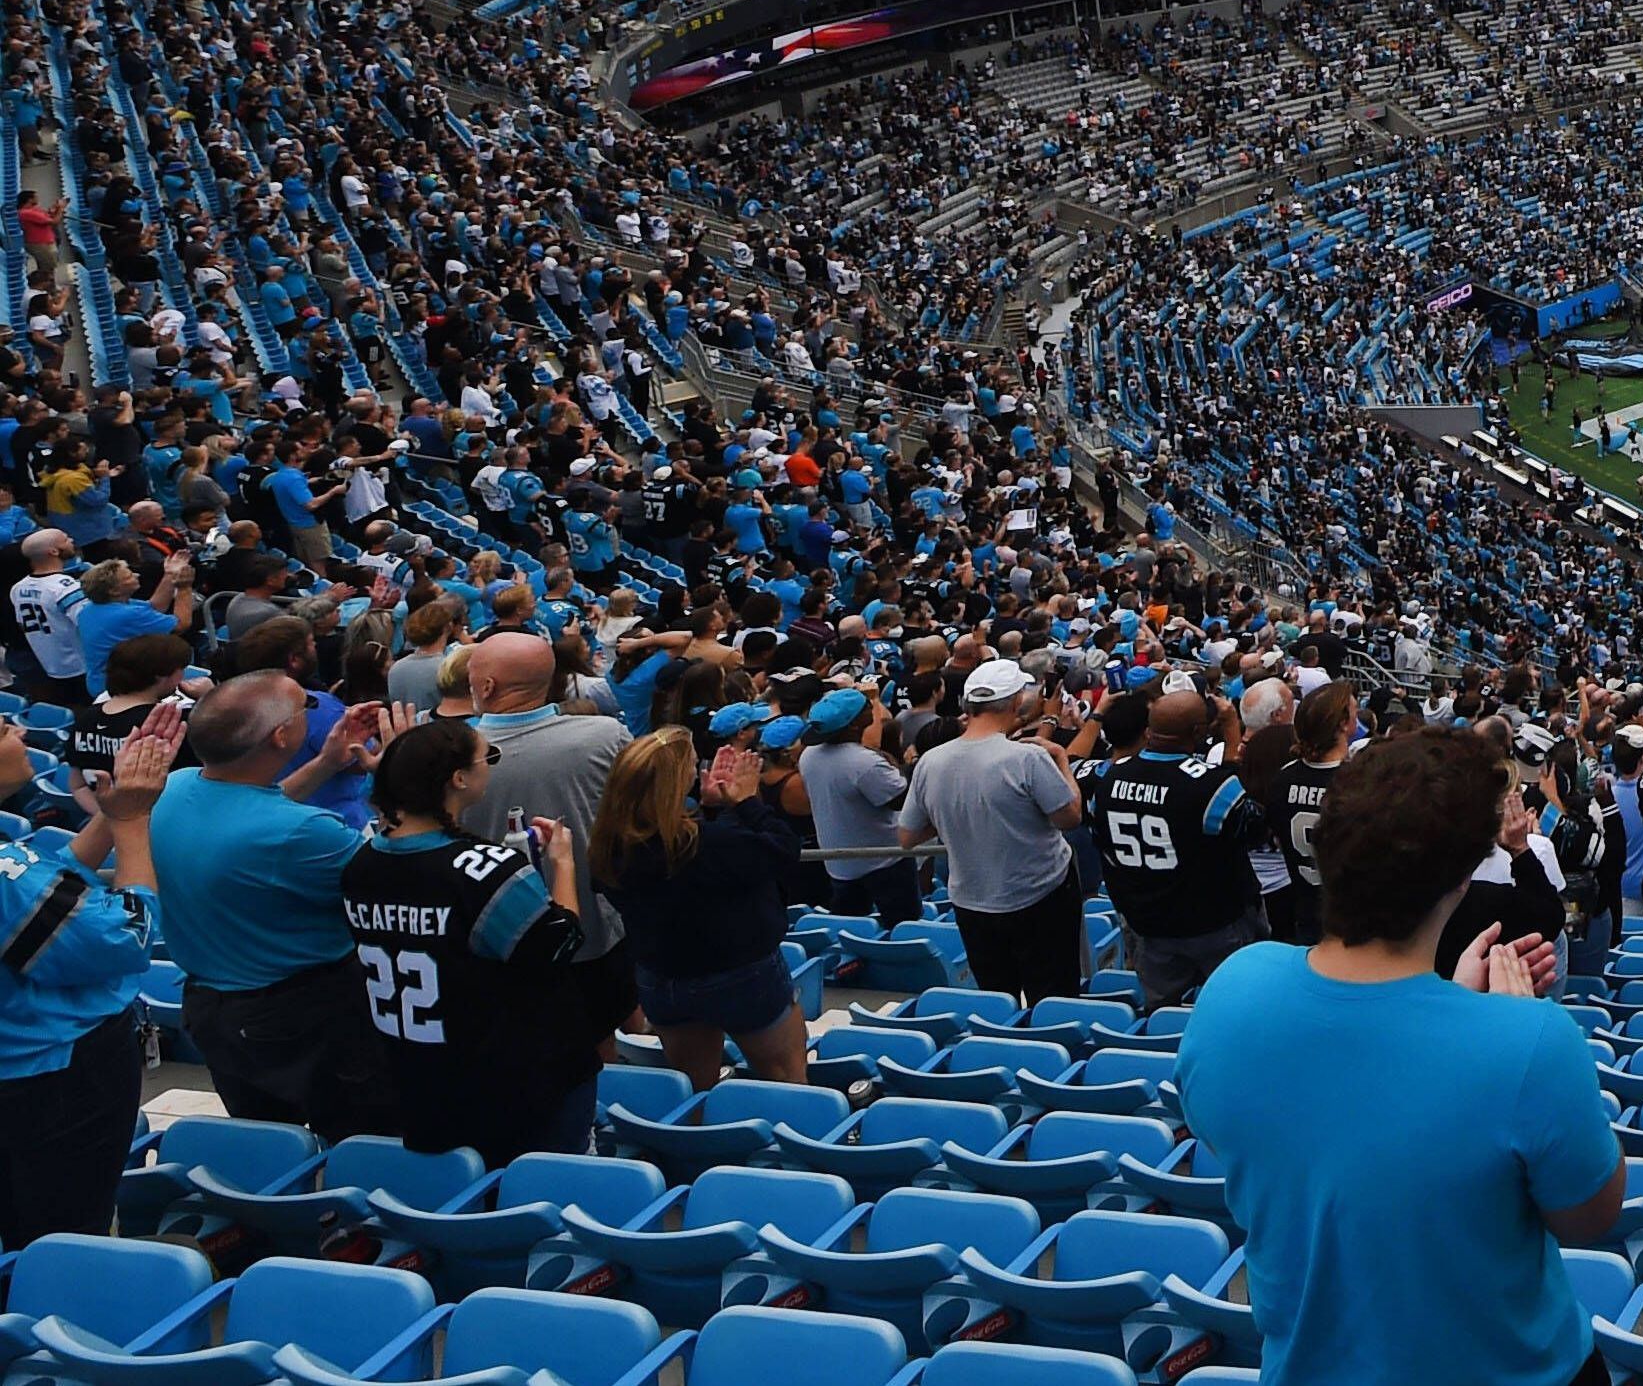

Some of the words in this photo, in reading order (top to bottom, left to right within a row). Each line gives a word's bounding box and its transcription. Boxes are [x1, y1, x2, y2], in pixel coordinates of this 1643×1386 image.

[1427, 283, 1473, 313] GEICO
[1109, 777, 1170, 806] KUECHLY
[1105, 811, 1179, 872] 59
[453, 843, 517, 883] 22
[343, 897, 452, 937] McCAFFREY
[357, 944, 446, 1045] 22
